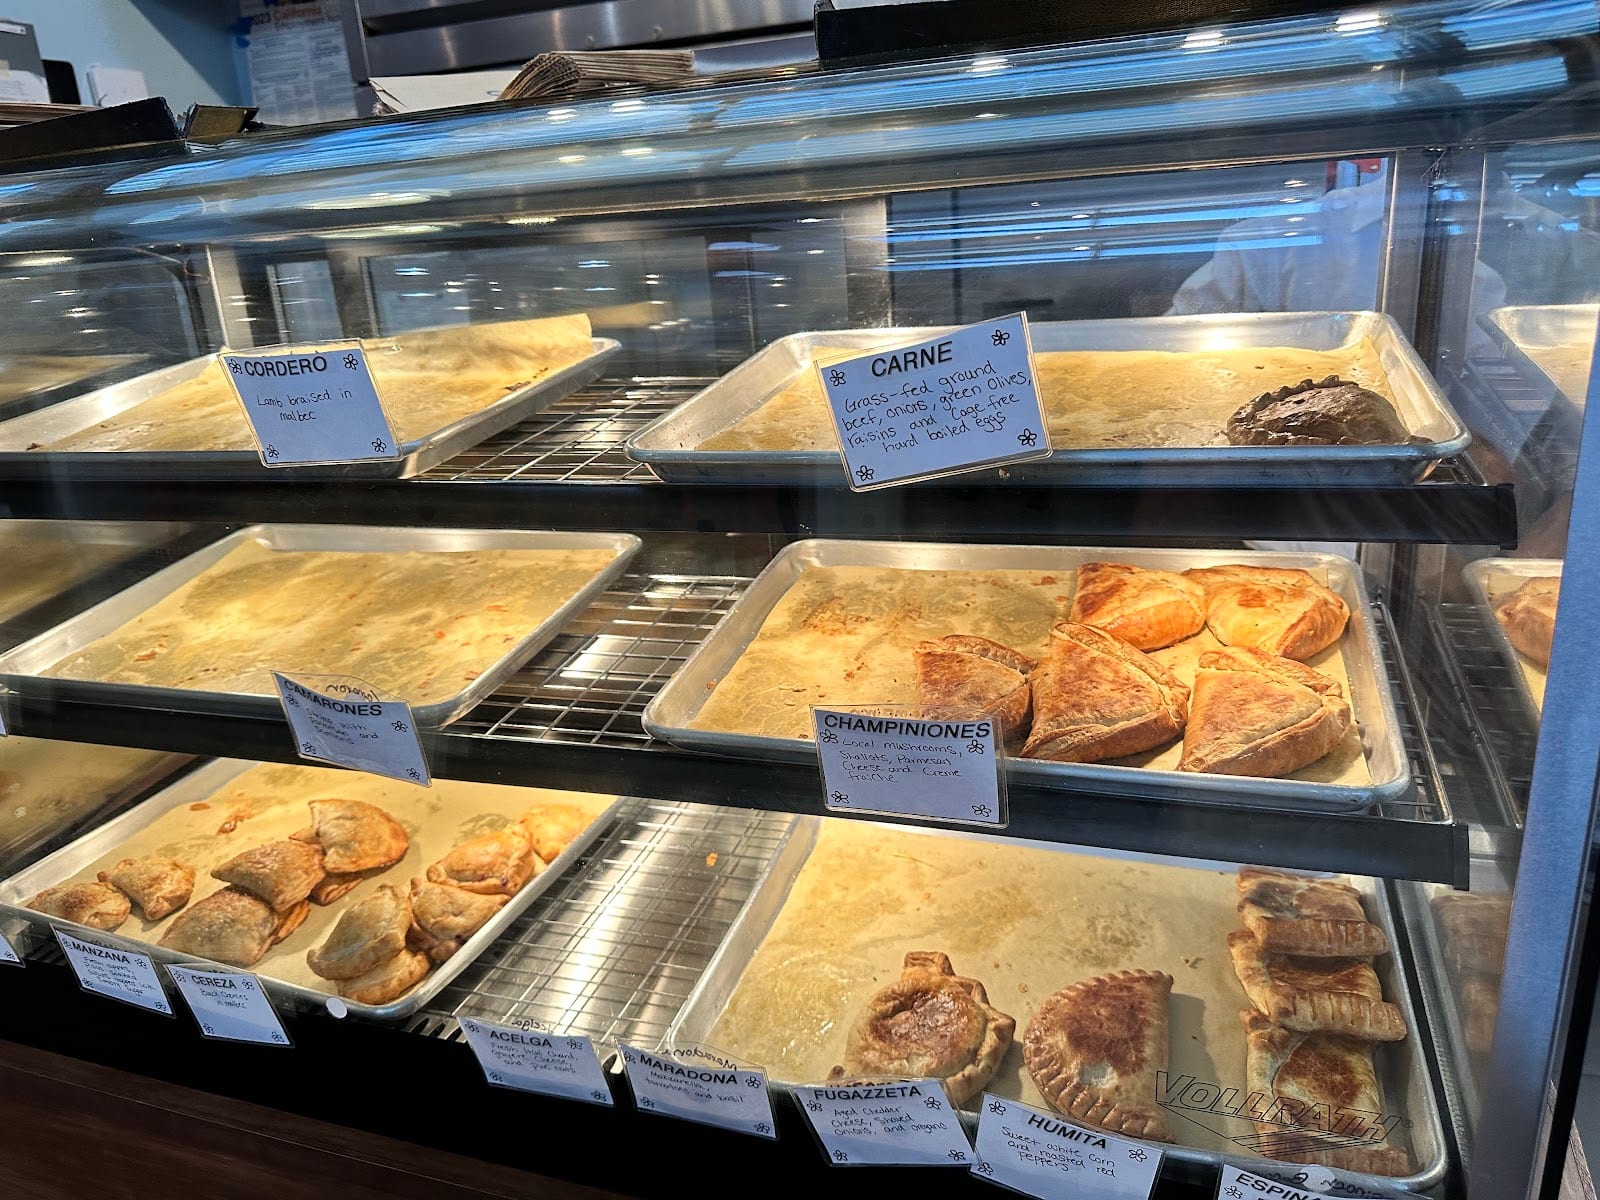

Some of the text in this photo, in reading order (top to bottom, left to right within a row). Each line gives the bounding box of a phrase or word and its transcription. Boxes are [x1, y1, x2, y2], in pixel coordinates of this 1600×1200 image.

[244, 355, 328, 378] CORDERO
[871, 341, 953, 378] CARNE
[257, 388, 352, 408] Lamb braised in
[845, 360, 997, 414] Grass-fed ground
[280, 410, 317, 422] malbec
[842, 409, 883, 432] beef,
[886, 399, 937, 420] onions,
[939, 386, 982, 411] green
[847, 426, 897, 449] raisins
[909, 414, 937, 430] and
[882, 411, 1006, 453] hard boiled eggs
[284, 679, 382, 716] CAMARONES
[339, 721, 367, 731] with
[359, 731, 379, 740] and
[824, 714, 991, 739] CHAMPINIONES
[842, 737, 875, 750] Local
[888, 765, 913, 774] and
[896, 754, 952, 766] Parmesan
[71, 941, 131, 965] MANZANA
[191, 975, 237, 990] CEREZA
[489, 1030, 553, 1048] ACELGA
[503, 1059, 523, 1067] and
[640, 1053, 738, 1085] MARADONA
[694, 1091, 713, 1100] and
[813, 1085, 922, 1100] FUGAZZETA
[1155, 1070, 1402, 1142] VOLLRATH
[883, 1123, 906, 1133] and
[1027, 1113, 1107, 1150] HUMITA
[1001, 1125, 1042, 1147] Sweet
[1046, 1142, 1083, 1158] white
[1007, 1140, 1117, 1178] and roasted red
[1235, 1173, 1323, 1200] ESPIN
